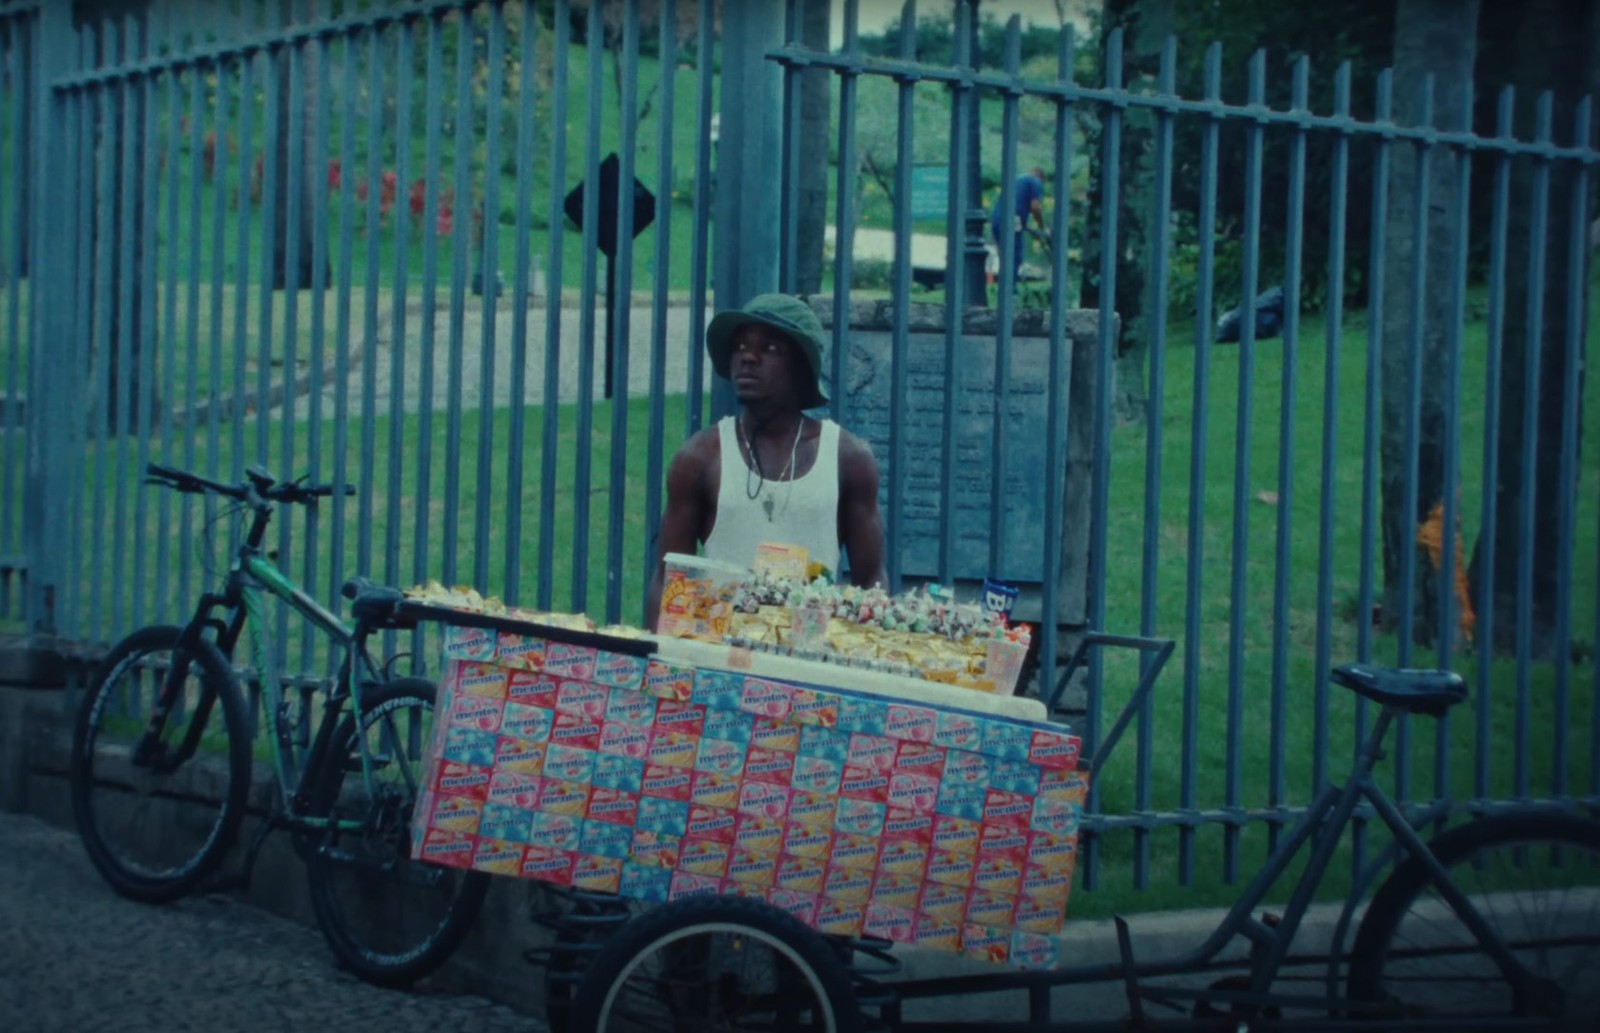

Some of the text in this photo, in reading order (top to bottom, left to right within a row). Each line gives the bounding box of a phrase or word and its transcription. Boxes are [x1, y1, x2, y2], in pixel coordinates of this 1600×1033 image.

[448, 638, 491, 650] mentos
[499, 643, 543, 654] mentos
[548, 655, 591, 667] mentos
[597, 665, 640, 677] mentos
[462, 675, 505, 686] mentos
[647, 673, 690, 684] mentos
[511, 683, 554, 695] mentos
[561, 693, 604, 704] mentos
[744, 693, 787, 705] mentos
[610, 702, 653, 713] mentos
[793, 699, 836, 711] mentos
[456, 708, 499, 719] mentos
[658, 711, 702, 723] mentos
[504, 717, 548, 729] mentos
[888, 718, 931, 730] mentos
[555, 726, 598, 737] mentos
[754, 728, 798, 739] mentos
[936, 726, 979, 738] mentos
[603, 735, 646, 746] mentos
[651, 744, 694, 755] mentos
[851, 746, 894, 758] mentos
[1032, 745, 1076, 756] mentos
[498, 751, 541, 763] mentos
[699, 752, 742, 763] mentos
[899, 754, 942, 765] mentos
[547, 758, 590, 770] mentos
[747, 761, 791, 772] mentos
[946, 764, 989, 775] mentos
[442, 775, 486, 787] mentos
[795, 770, 838, 781] mentos
[645, 777, 688, 788] mentos
[843, 778, 886, 790] mentos
[1042, 780, 1085, 792] mentos
[492, 785, 535, 796] mentos
[694, 785, 737, 796] mentos
[892, 786, 935, 798] mentos
[542, 793, 585, 805] mentos
[742, 795, 786, 806] mentos
[591, 801, 634, 812] mentos
[790, 803, 834, 814] mentos
[986, 804, 1029, 816] mentos
[435, 809, 478, 820] mentos
[838, 812, 881, 824] mentos
[1034, 812, 1077, 823] mentos
[690, 819, 733, 830] mentos
[887, 819, 930, 831] mentos
[534, 826, 577, 838] mentos
[738, 828, 781, 840] mentos
[935, 830, 978, 841] mentos
[427, 842, 470, 853] mentos
[633, 841, 676, 853] mentos
[786, 836, 829, 847] mentos
[982, 837, 1025, 849] mentos
[833, 846, 876, 858] mentos
[1030, 844, 1074, 856] mentos
[476, 851, 519, 863] mentos
[682, 853, 725, 864] mentos
[881, 852, 925, 864] mentos
[525, 859, 569, 871] mentos
[730, 862, 774, 873] mentos
[930, 863, 973, 874] mentos
[574, 868, 618, 879] mentos
[779, 869, 822, 881] mentos
[976, 870, 1019, 881] mentos
[826, 879, 869, 891] mentos
[1024, 877, 1068, 889] mentos
[874, 885, 918, 897] mentos
[922, 896, 965, 907] mentos
[969, 902, 1012, 914] mentos
[818, 912, 861, 924] mentos
[1017, 910, 1060, 921] mentos
[868, 917, 911, 929] mentos
[915, 928, 958, 939] mentos
[963, 935, 1007, 947] mentos
[1012, 946, 1056, 957] mentos
